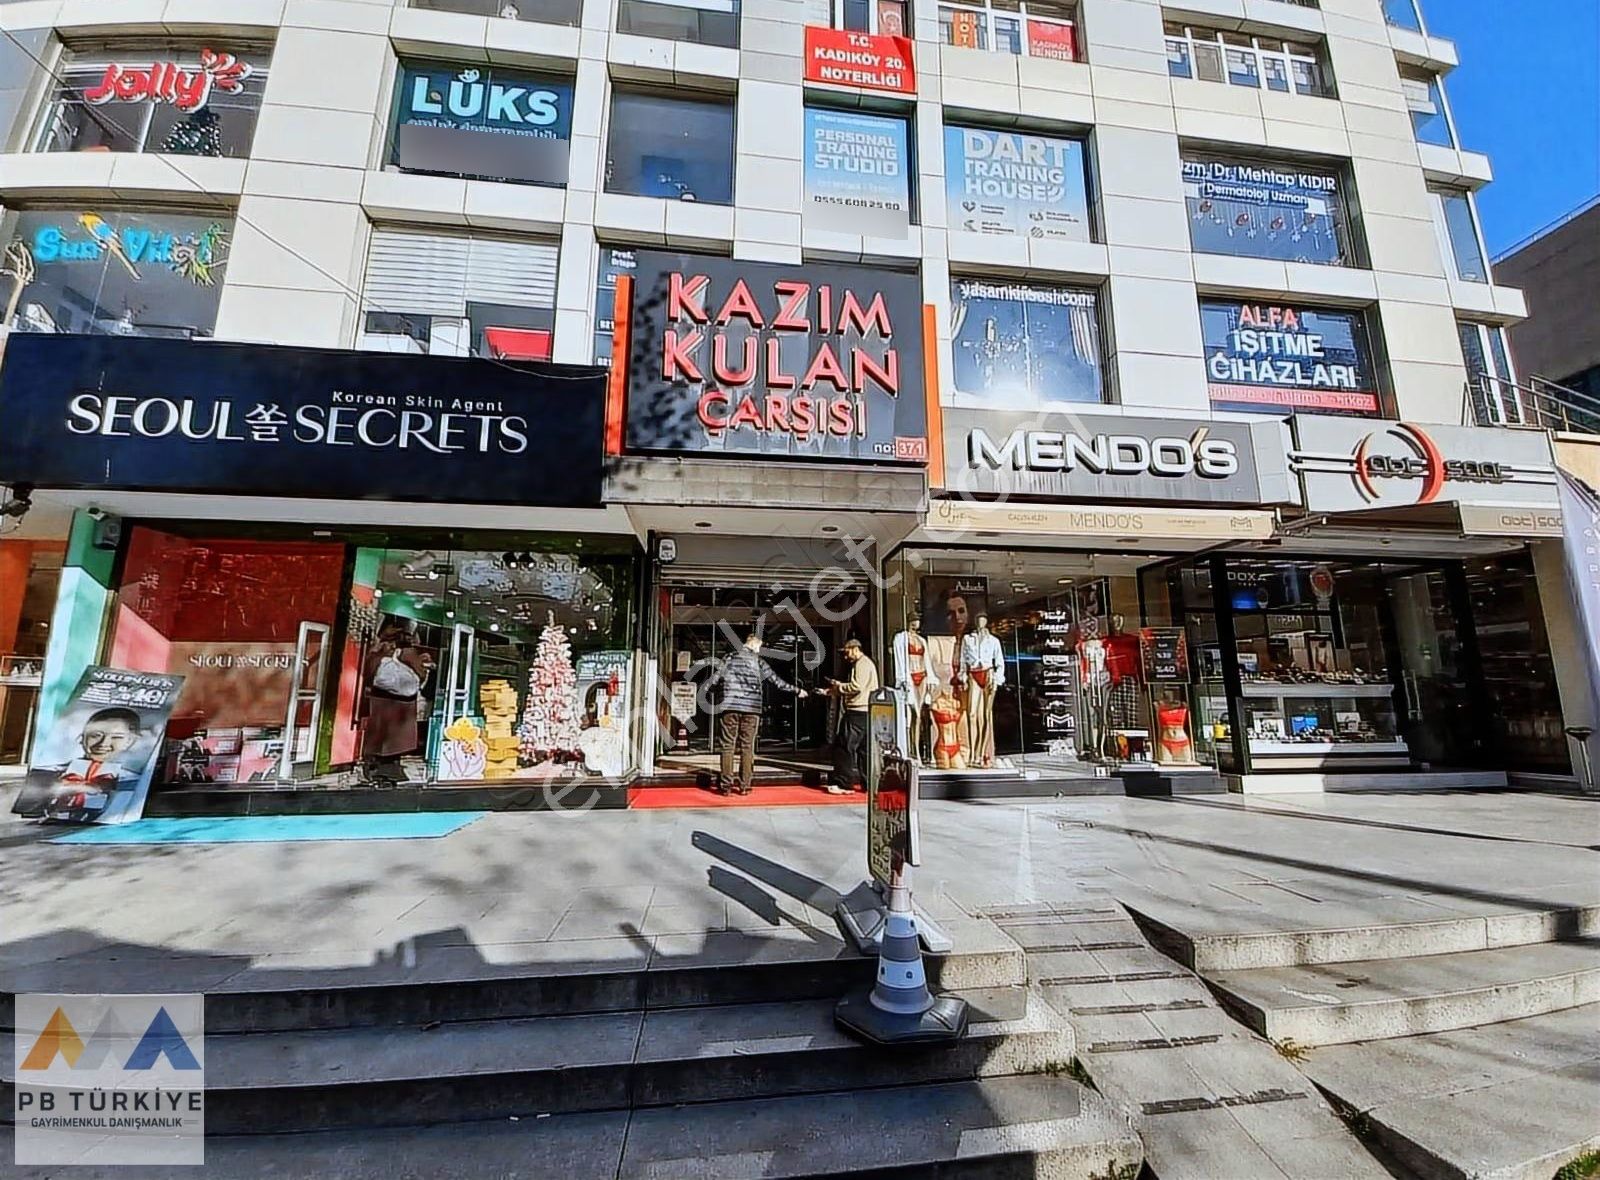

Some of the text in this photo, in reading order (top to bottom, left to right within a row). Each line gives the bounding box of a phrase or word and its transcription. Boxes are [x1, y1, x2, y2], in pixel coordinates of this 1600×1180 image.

[847, 34, 874, 48] T.C.
[814, 46, 881, 67] KADIKÖY
[83, 61, 214, 114] Jolly
[820, 66, 902, 88] NOTERLİĞİ
[815, 128, 897, 147] PERSONAL
[962, 128, 1070, 168] DART
[814, 140, 897, 160] TRAINING
[814, 154, 898, 176] STUDIO
[964, 160, 1065, 184] TRAINING
[964, 177, 1049, 202] HOUSE
[1238, 166, 1296, 187] Mehtap
[1298, 173, 1336, 190] KIDIR
[668, 272, 893, 339] KAZIM
[1239, 304, 1298, 329] ALFA
[662, 329, 899, 397] KULAN
[332, 390, 504, 413] Korean Skin Agent
[65, 393, 245, 441] SEOUL
[292, 404, 528, 454] SECRETS
[697, 391, 868, 440] ÇARŞISI
[897, 441, 924, 458] 371
[967, 426, 1239, 477] MENDO'S
[1070, 513, 1144, 530] MENDO'S
